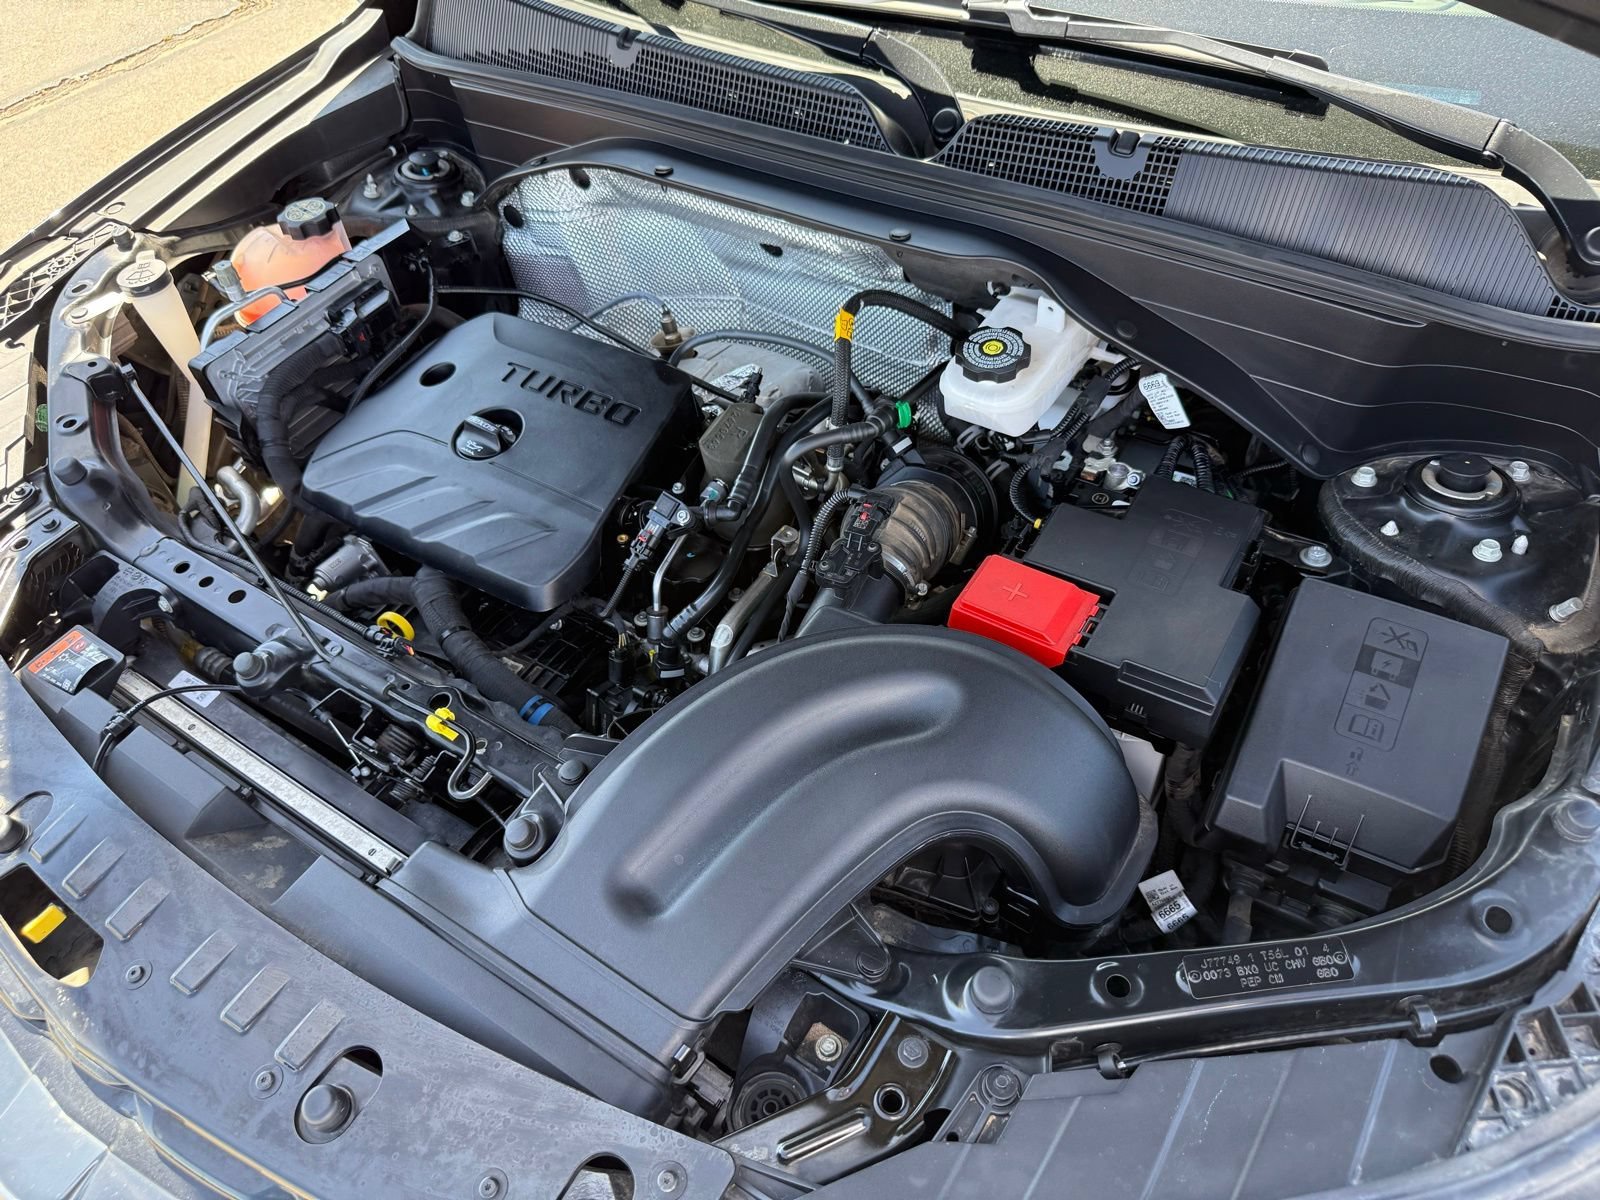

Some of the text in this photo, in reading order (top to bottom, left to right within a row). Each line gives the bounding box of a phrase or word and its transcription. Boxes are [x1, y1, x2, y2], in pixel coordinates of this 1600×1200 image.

[502, 362, 642, 426] TURBO
[1158, 900, 1181, 920] 6665
[1166, 913, 1190, 930] 6665
[1201, 954, 1241, 969] J77749
[1202, 968, 1232, 981] 0073
[1263, 961, 1279, 973] UC
[1240, 976, 1262, 989] PEP
